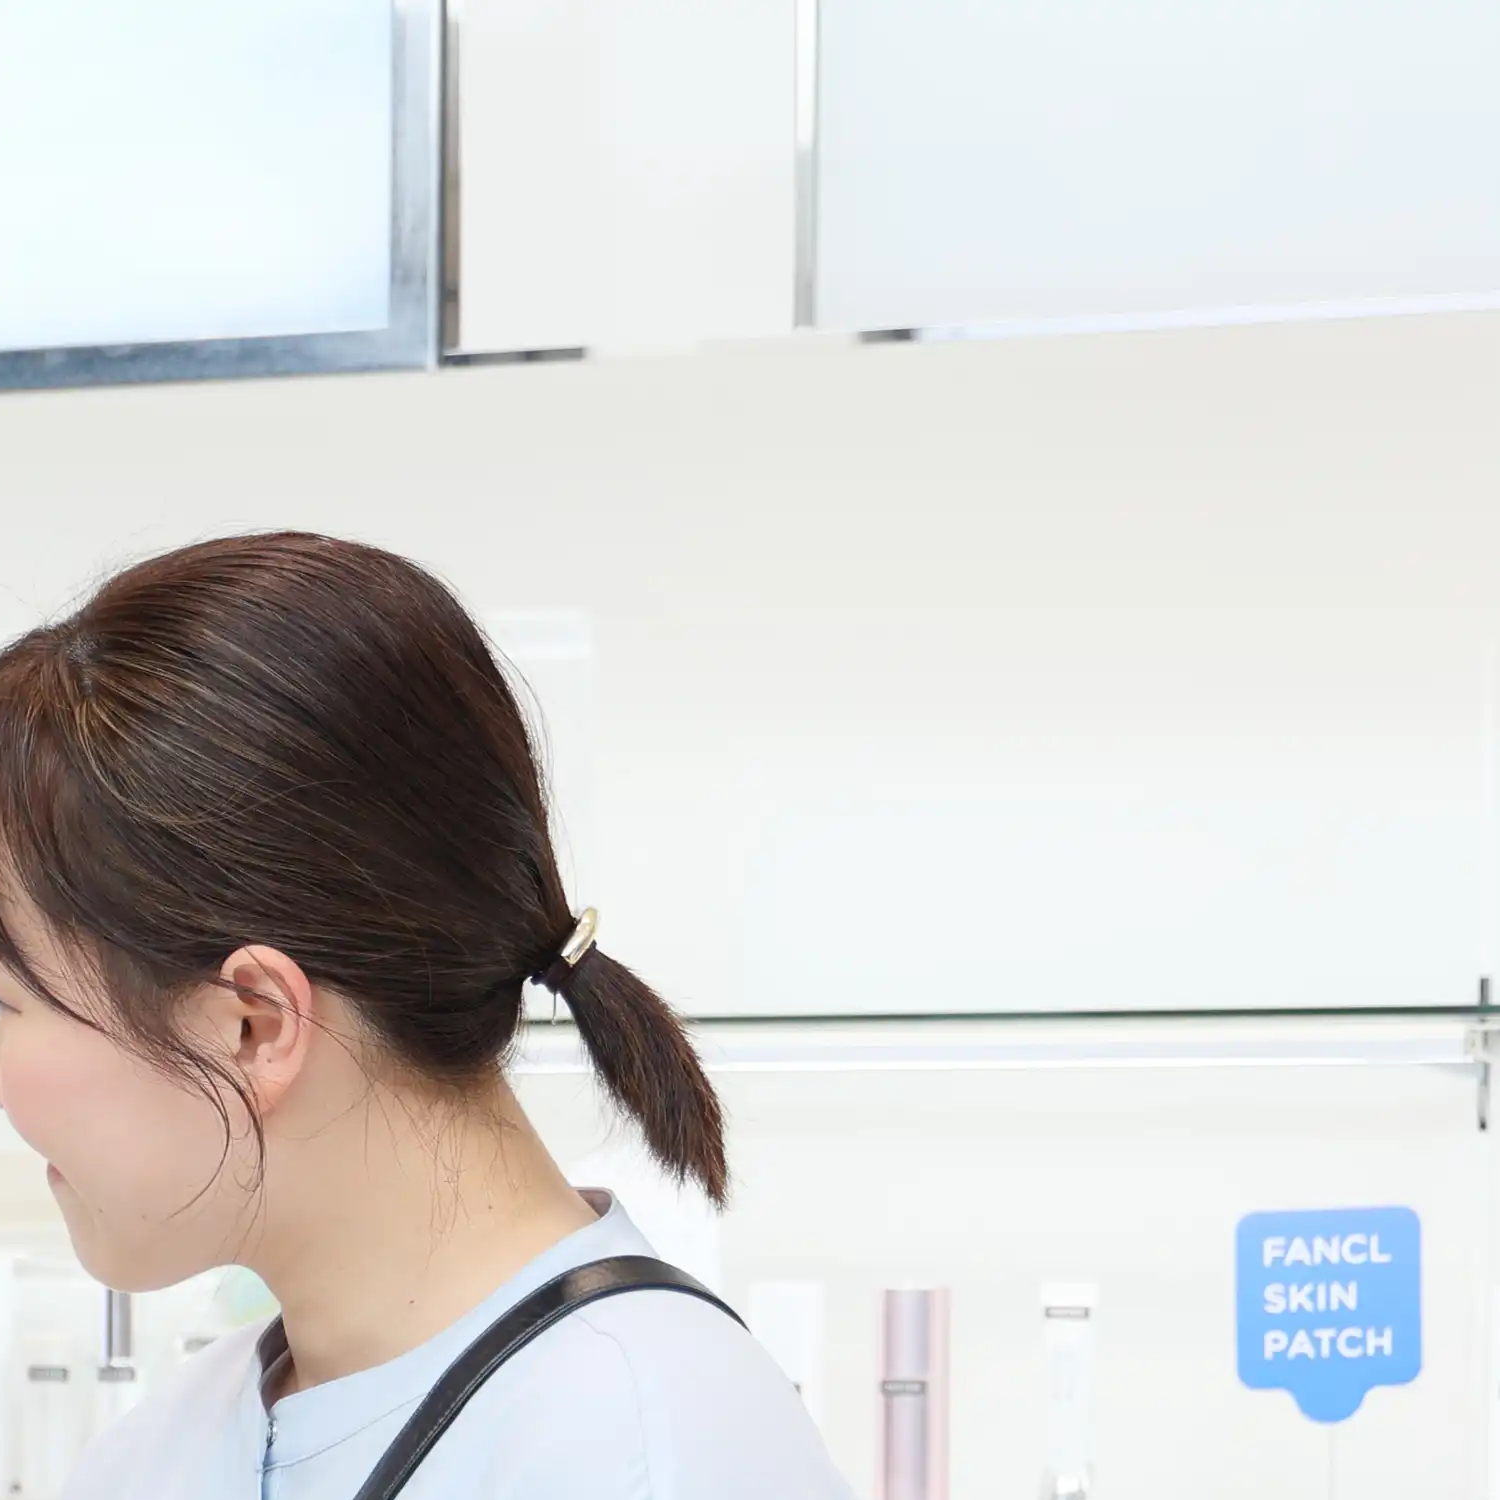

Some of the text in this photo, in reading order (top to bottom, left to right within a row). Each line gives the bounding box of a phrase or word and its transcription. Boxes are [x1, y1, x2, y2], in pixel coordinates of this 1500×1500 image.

[1262, 1232, 1393, 1268] FANCL
[1263, 1281, 1358, 1314] SKIN
[1263, 1326, 1393, 1360] PATCH
